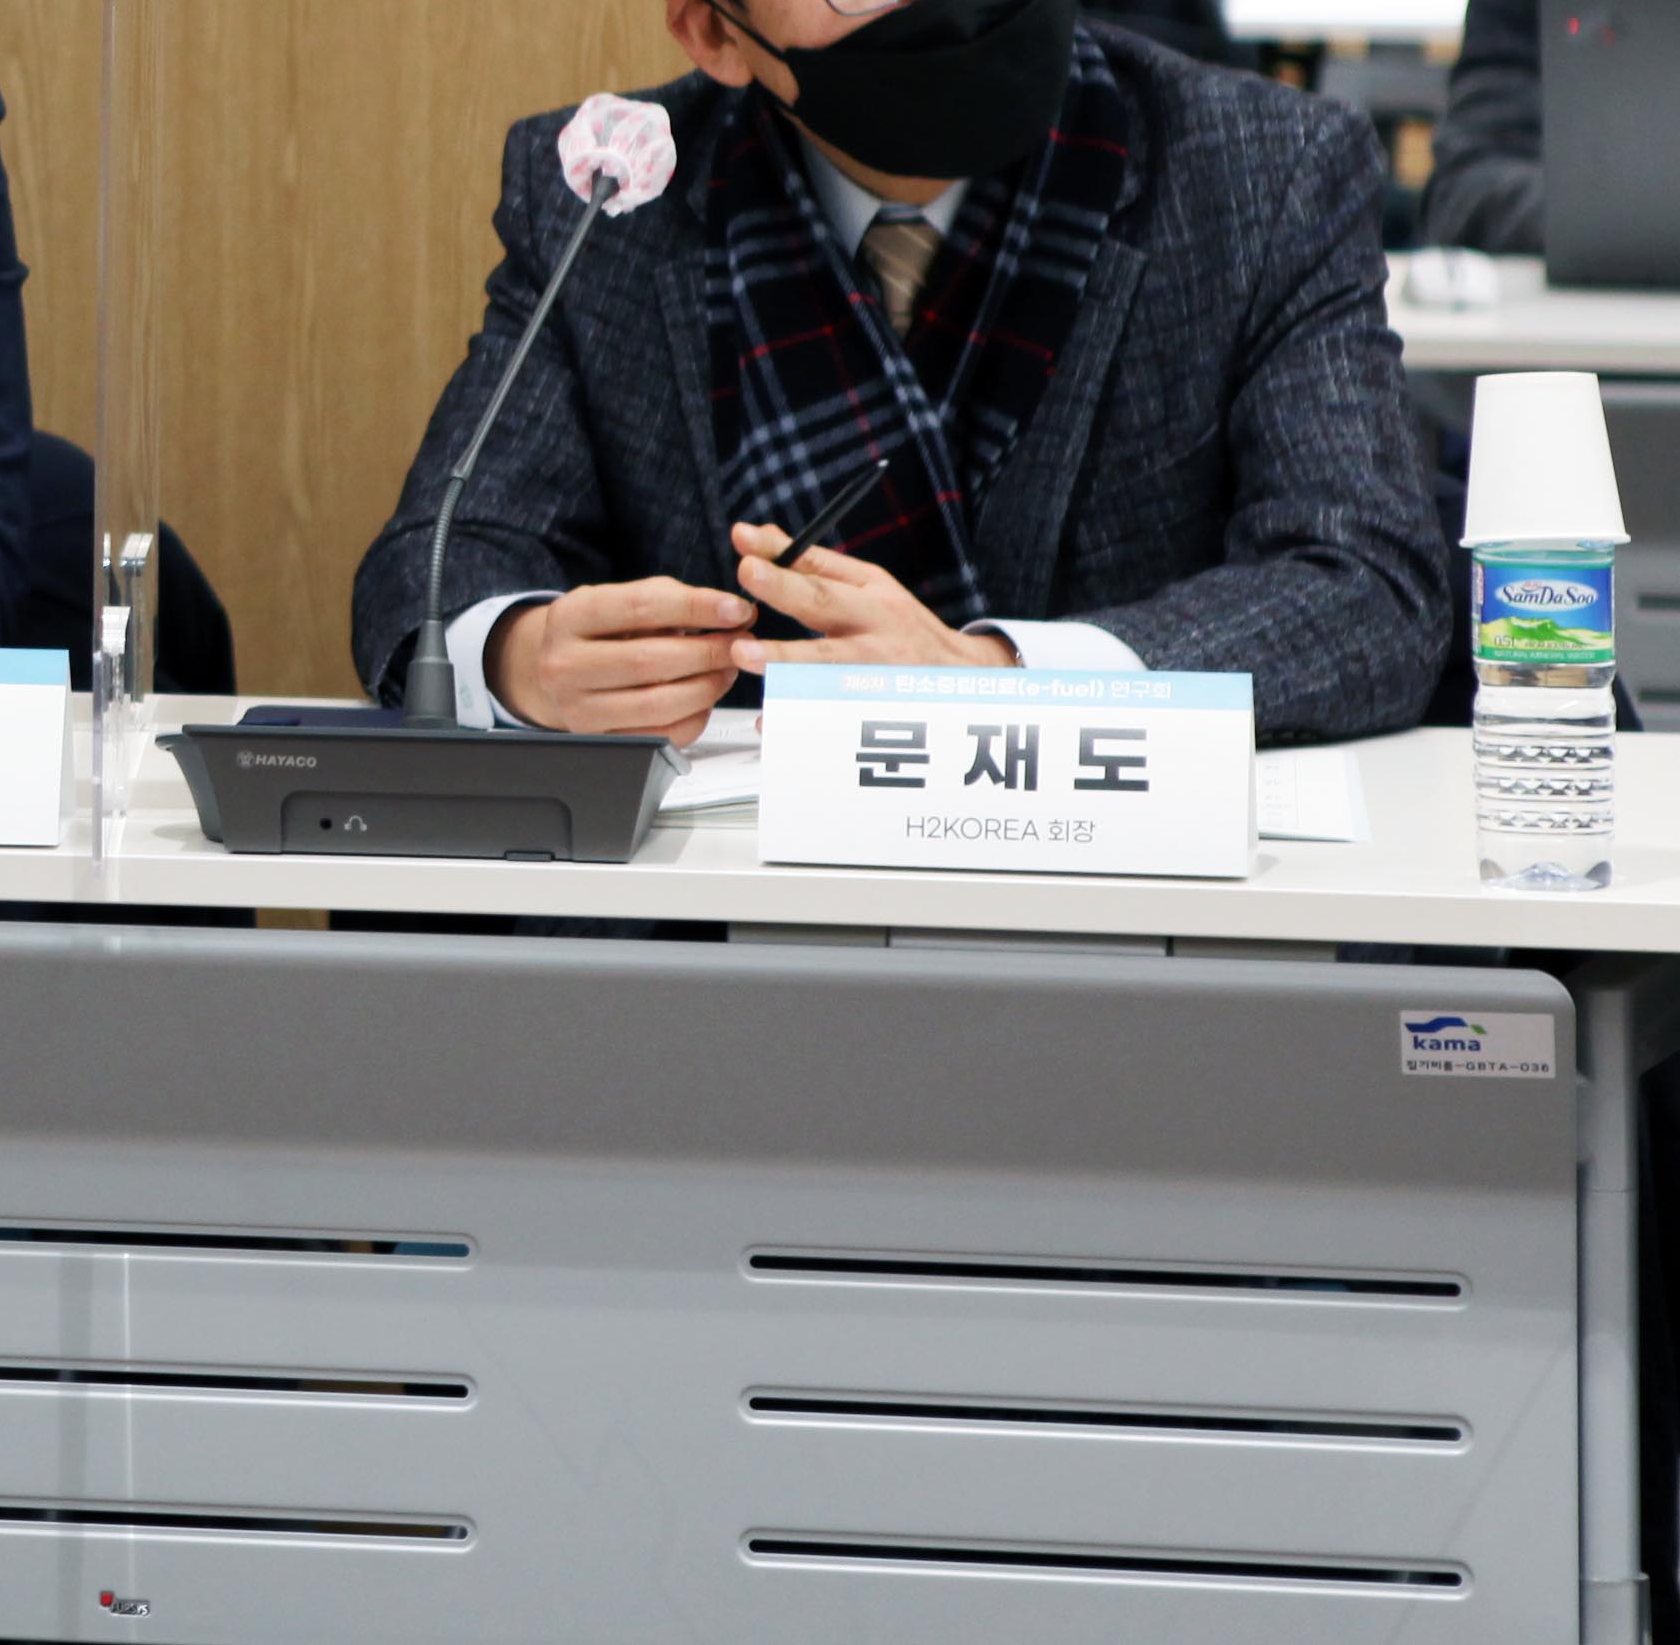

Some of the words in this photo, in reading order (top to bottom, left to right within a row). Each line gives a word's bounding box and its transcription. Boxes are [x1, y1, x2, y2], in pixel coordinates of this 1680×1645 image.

[1503, 586, 1595, 606] SamDaSoo
[894, 674, 1105, 700] 탄소중립연료(e-fuel)
[1110, 680, 1172, 700] 연구회
[255, 754, 316, 769] HAYACO
[905, 815, 1040, 842] H2KOREA
[1047, 818, 1096, 844] 회장
[1413, 1035, 1482, 1052] kama
